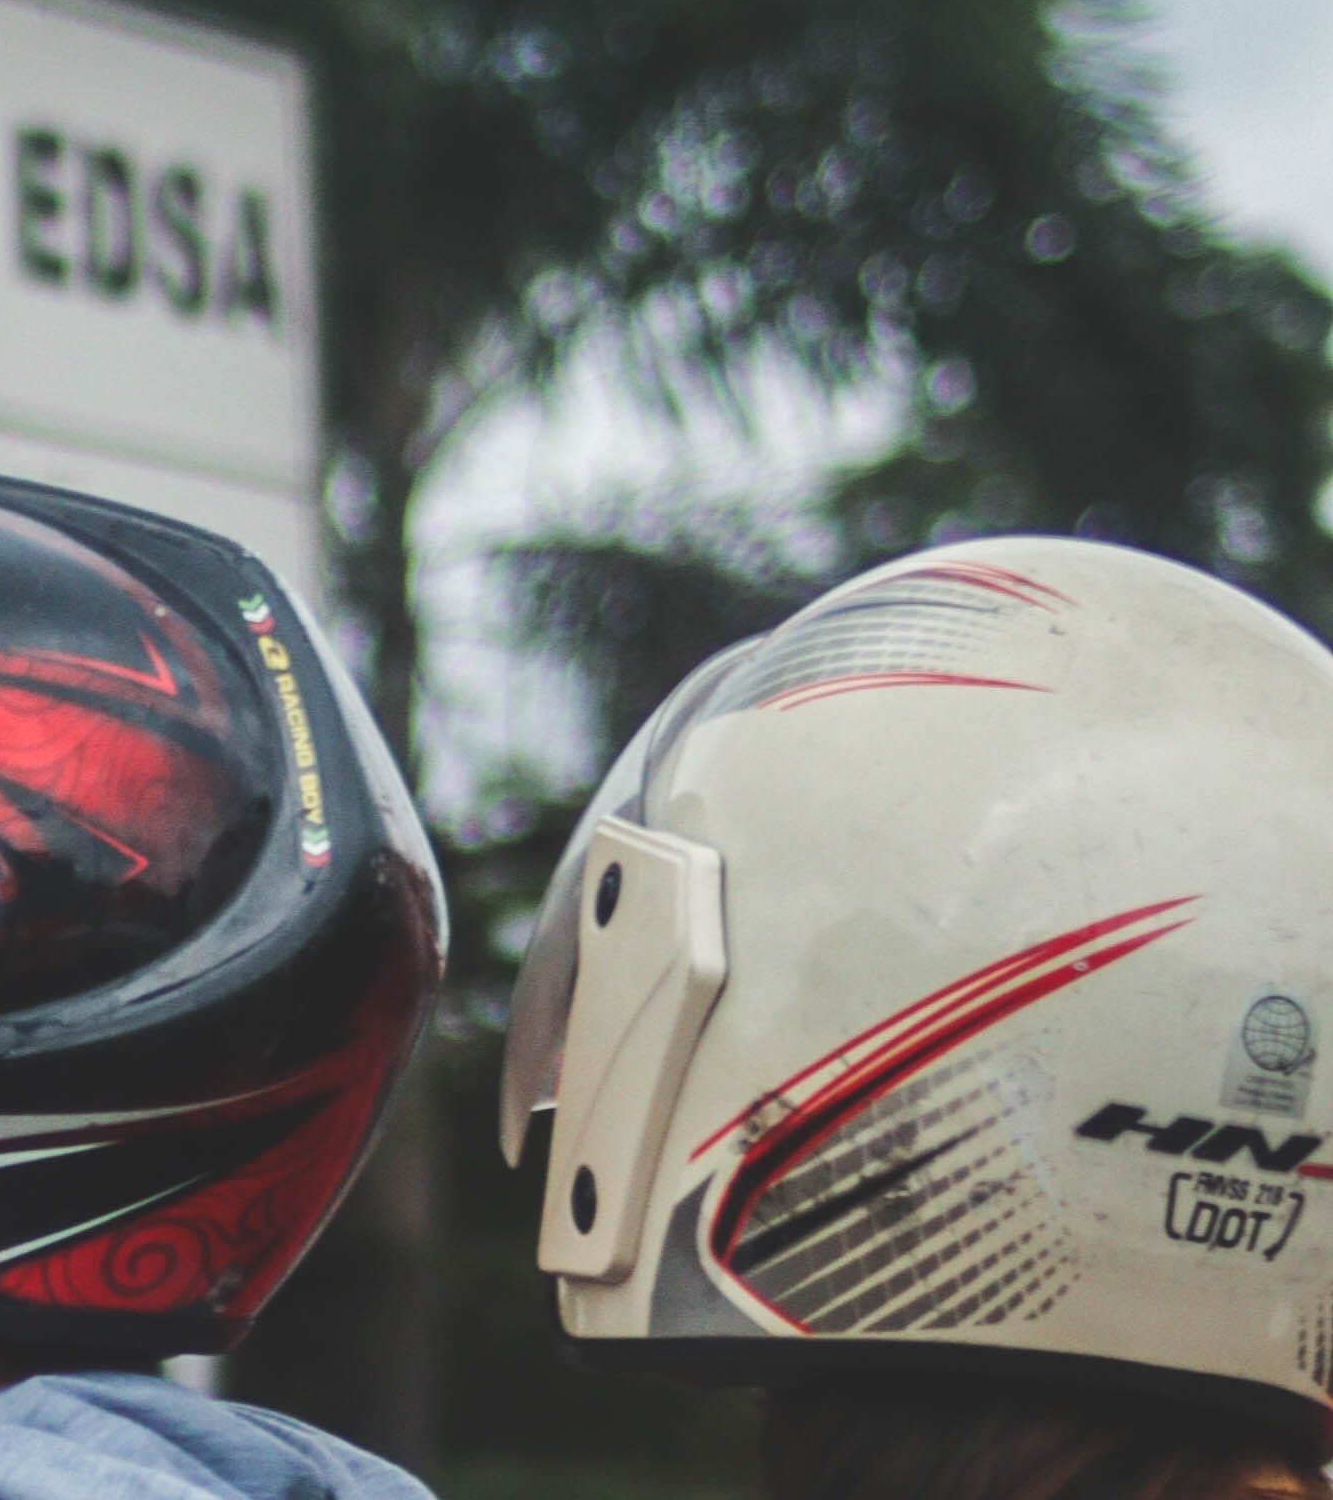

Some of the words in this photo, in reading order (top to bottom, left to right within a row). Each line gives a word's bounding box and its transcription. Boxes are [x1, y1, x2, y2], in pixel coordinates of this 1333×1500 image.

[14, 124, 283, 336] EDSA
[274, 671, 318, 768] RACING
[297, 771, 324, 825] BOY
